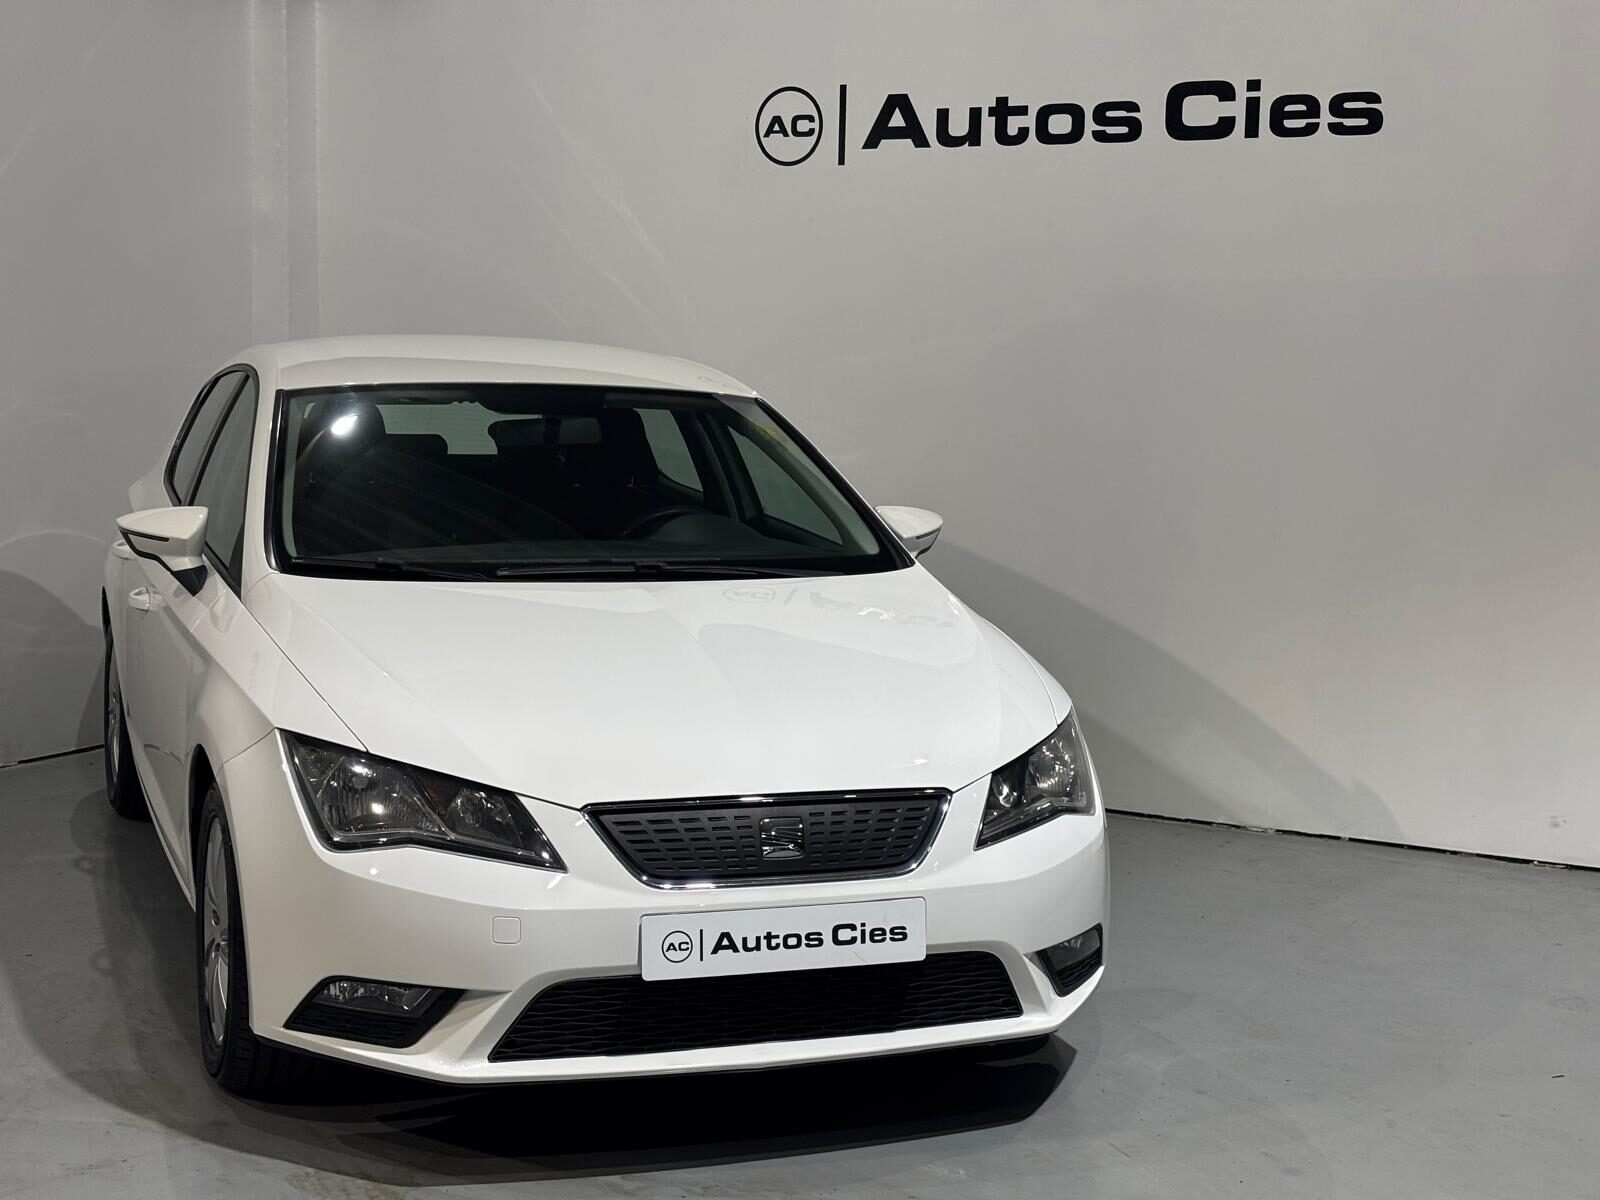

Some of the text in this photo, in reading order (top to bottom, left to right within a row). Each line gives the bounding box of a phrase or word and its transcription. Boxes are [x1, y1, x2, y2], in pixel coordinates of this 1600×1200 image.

[762, 78, 1384, 150] AC Autos Cies
[665, 922, 908, 955] AC Autos Cies
